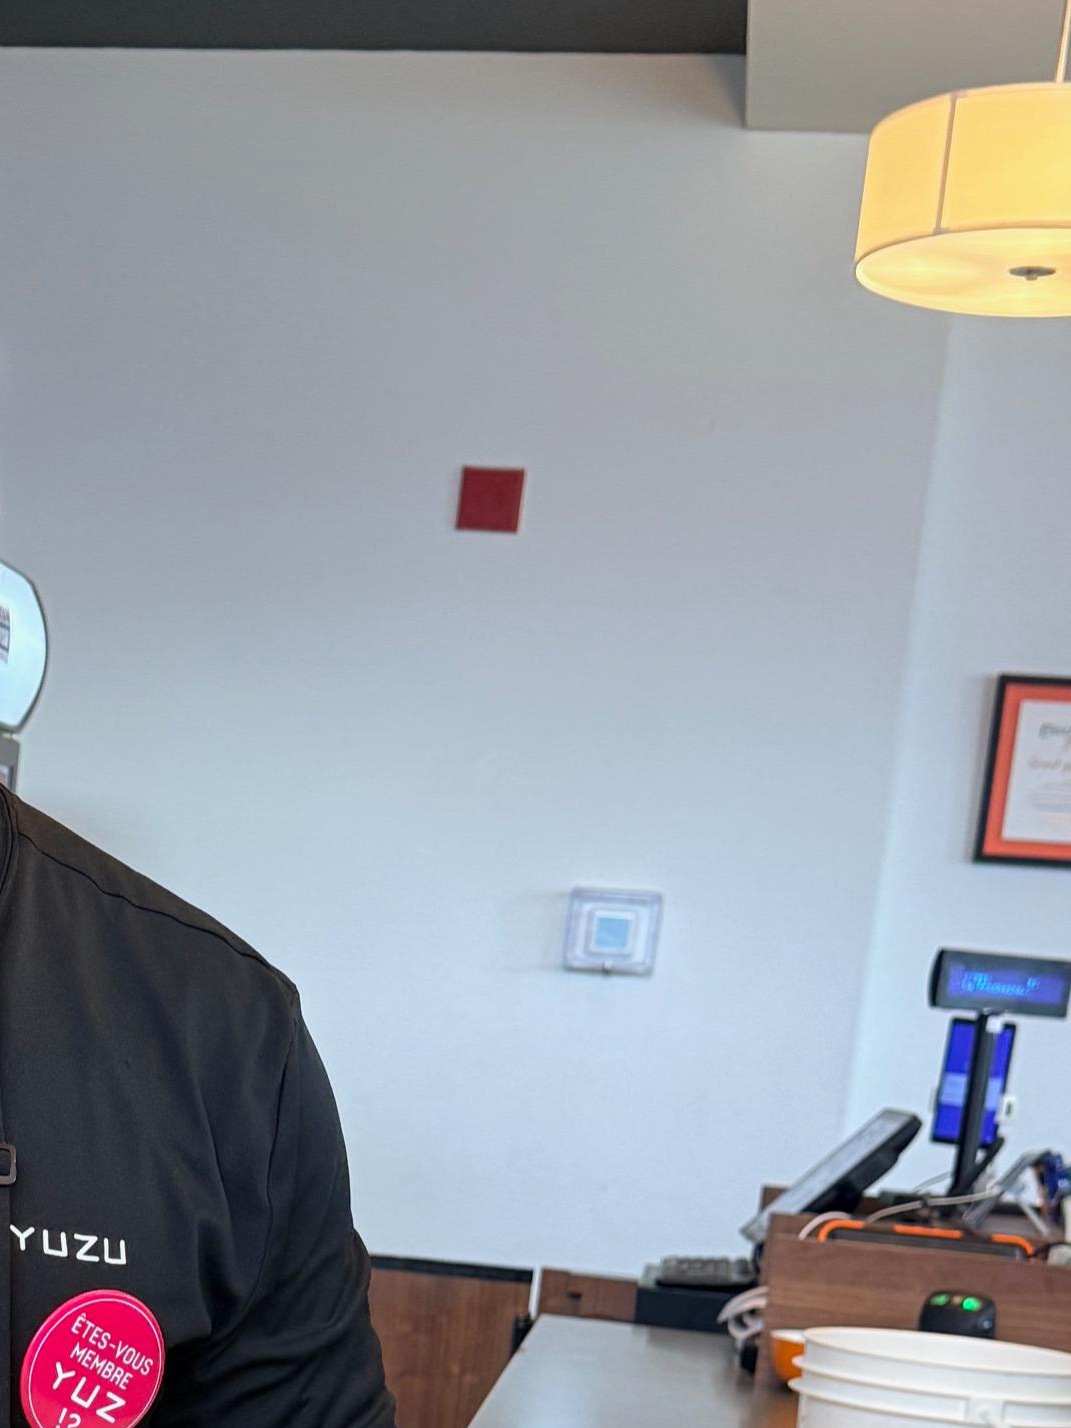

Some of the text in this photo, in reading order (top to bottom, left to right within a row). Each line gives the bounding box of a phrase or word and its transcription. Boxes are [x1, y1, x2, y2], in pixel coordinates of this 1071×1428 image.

[9, 1224, 127, 1265] YUZU
[69, 1341, 134, 1390] MEMBRE
[70, 1312, 154, 1376] ÊTES-VOUS
[52, 1361, 126, 1424] YUZ
